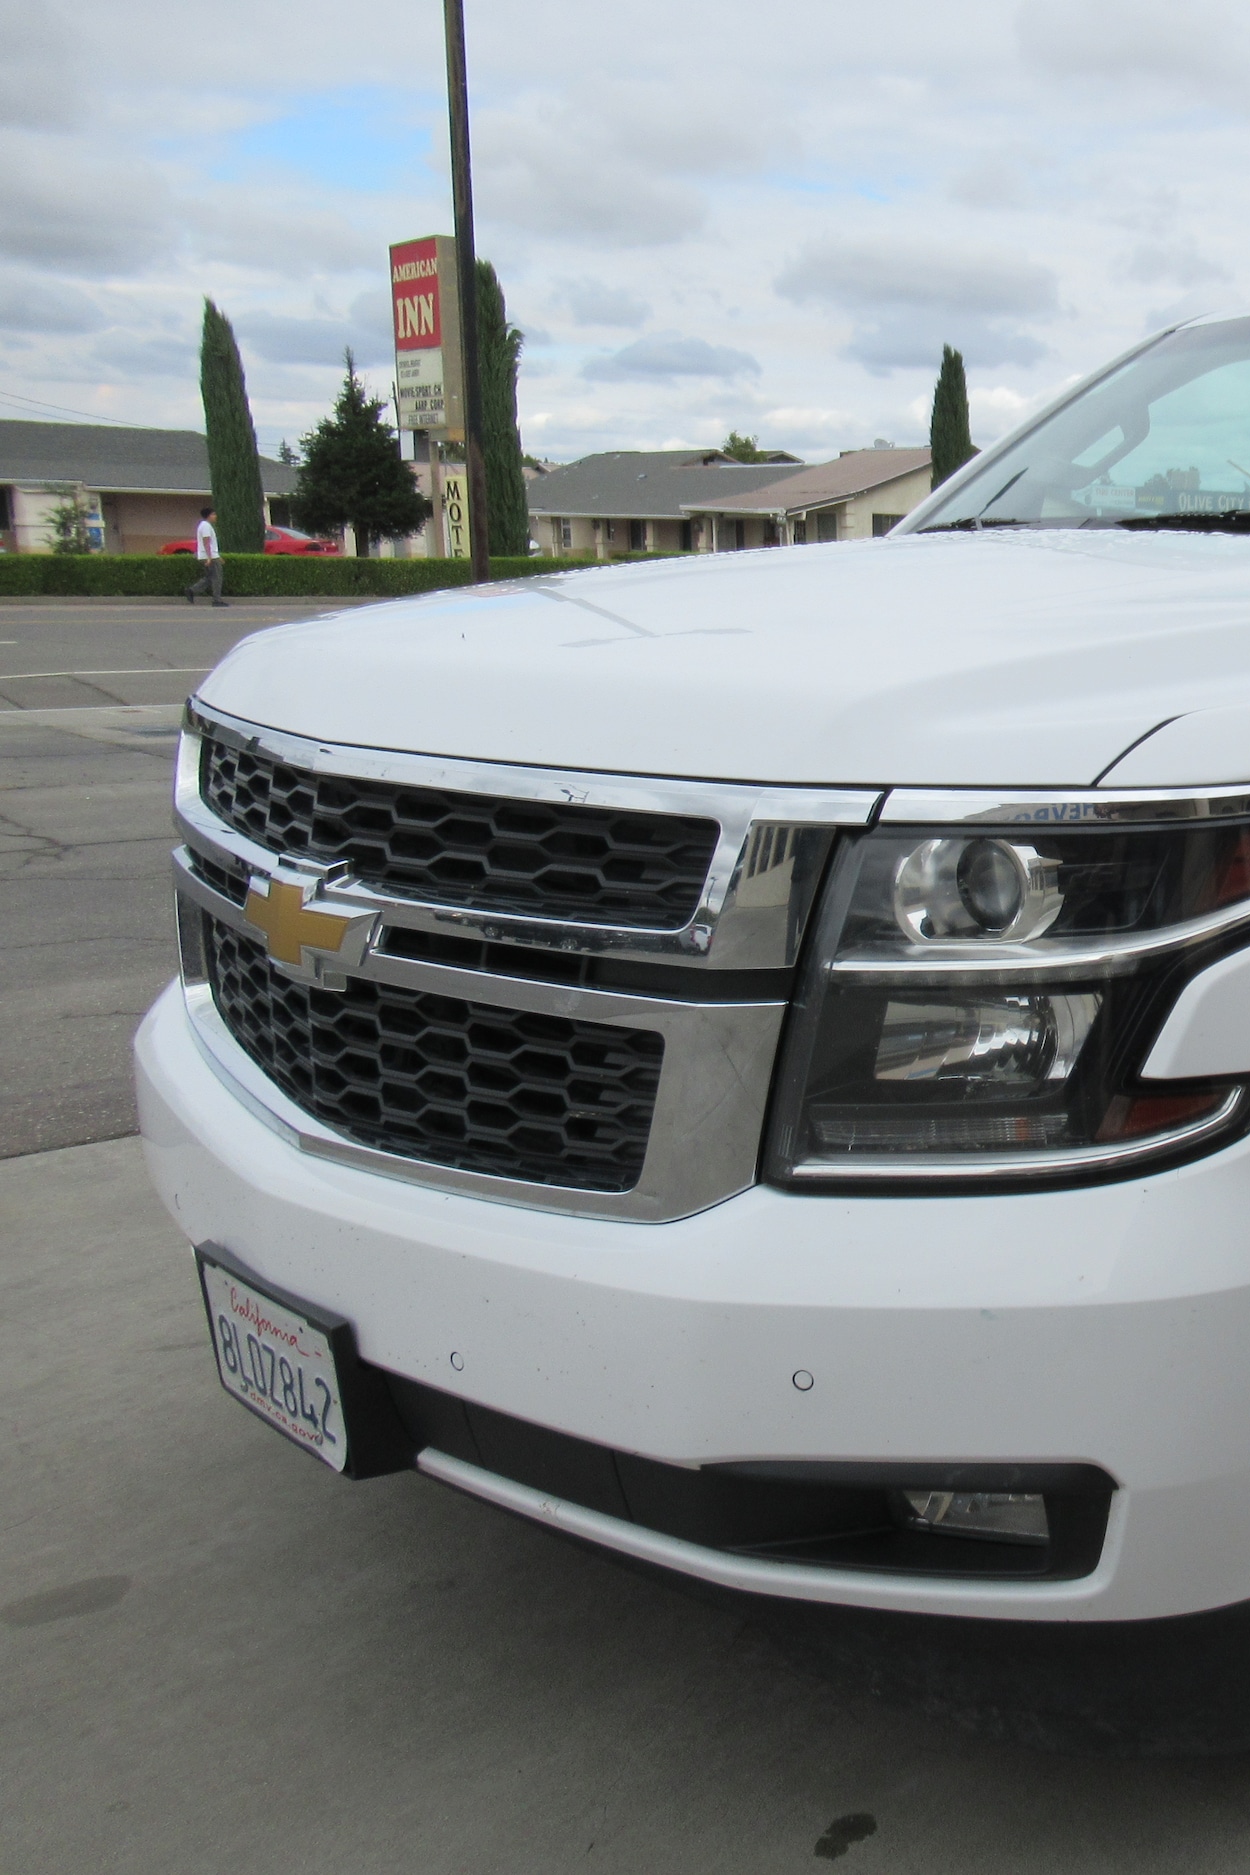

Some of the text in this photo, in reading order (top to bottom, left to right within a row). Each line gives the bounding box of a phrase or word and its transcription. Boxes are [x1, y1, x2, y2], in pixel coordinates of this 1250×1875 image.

[393, 258, 438, 282] AMERICAN
[396, 292, 434, 339] INN
[1180, 493, 1213, 511] OLIVE
[230, 1287, 309, 1357] California
